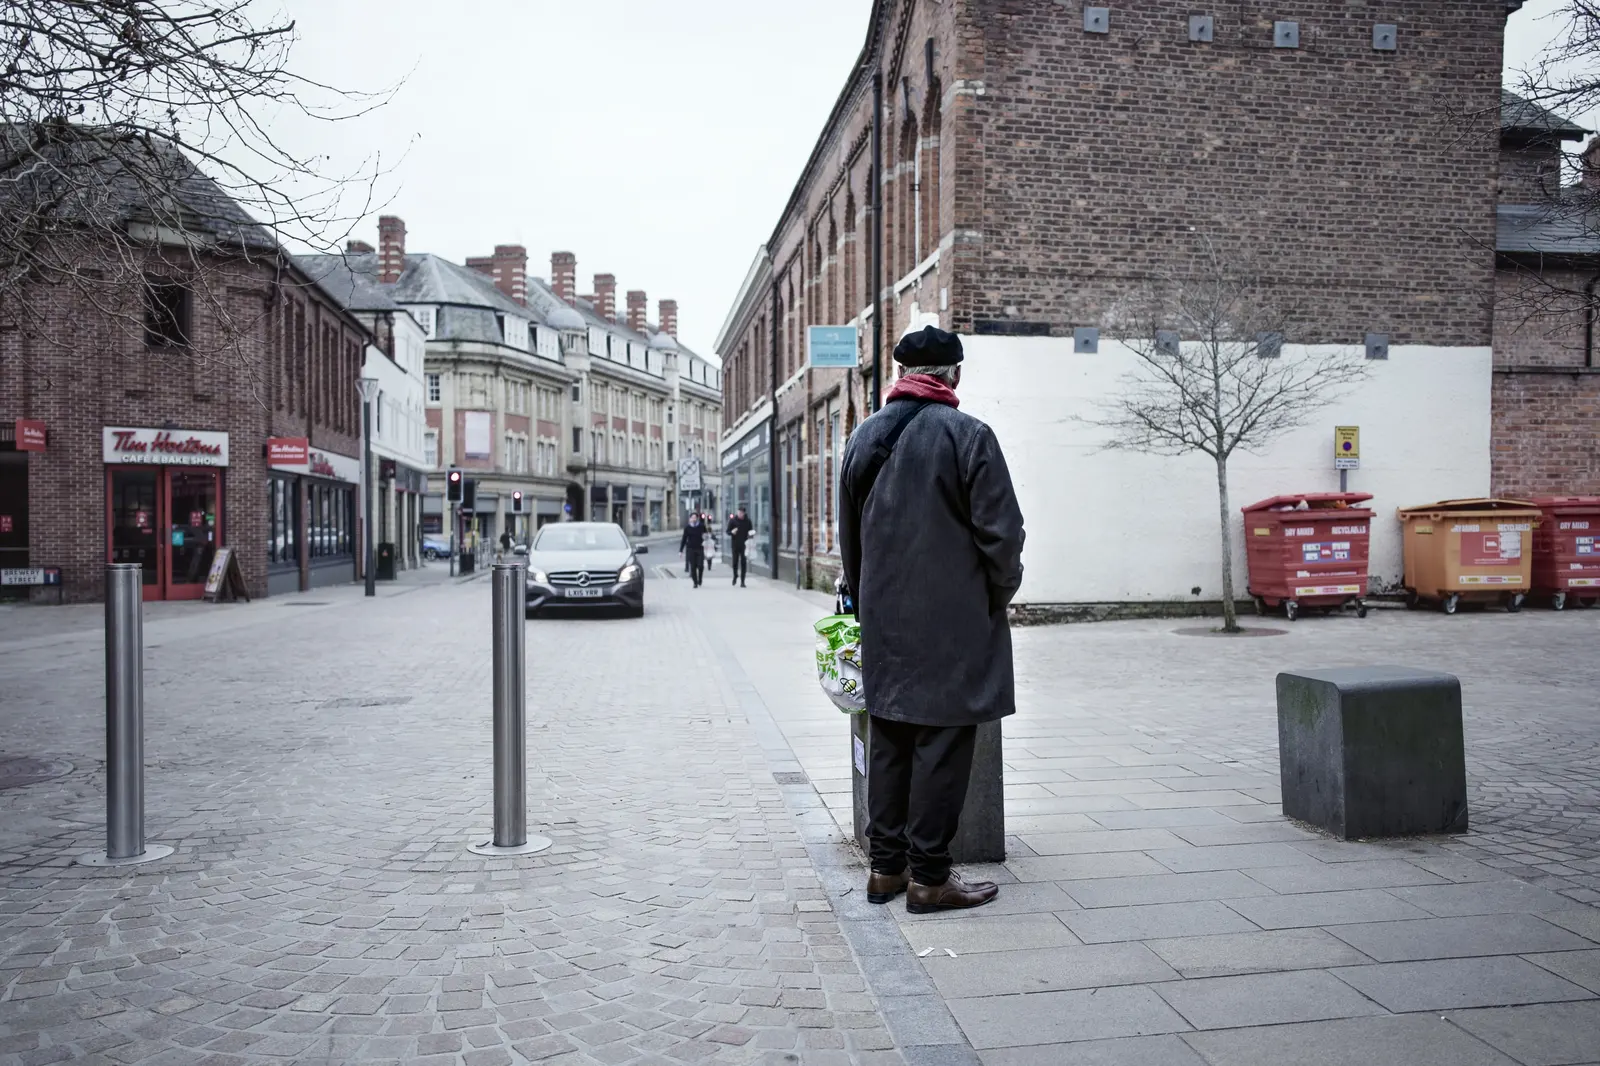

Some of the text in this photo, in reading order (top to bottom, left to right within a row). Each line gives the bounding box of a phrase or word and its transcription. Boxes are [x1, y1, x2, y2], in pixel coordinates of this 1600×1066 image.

[112, 431, 222, 455] Tim Hortons
[161, 455, 189, 464] BAKE
[190, 456, 218, 465] SHOP
